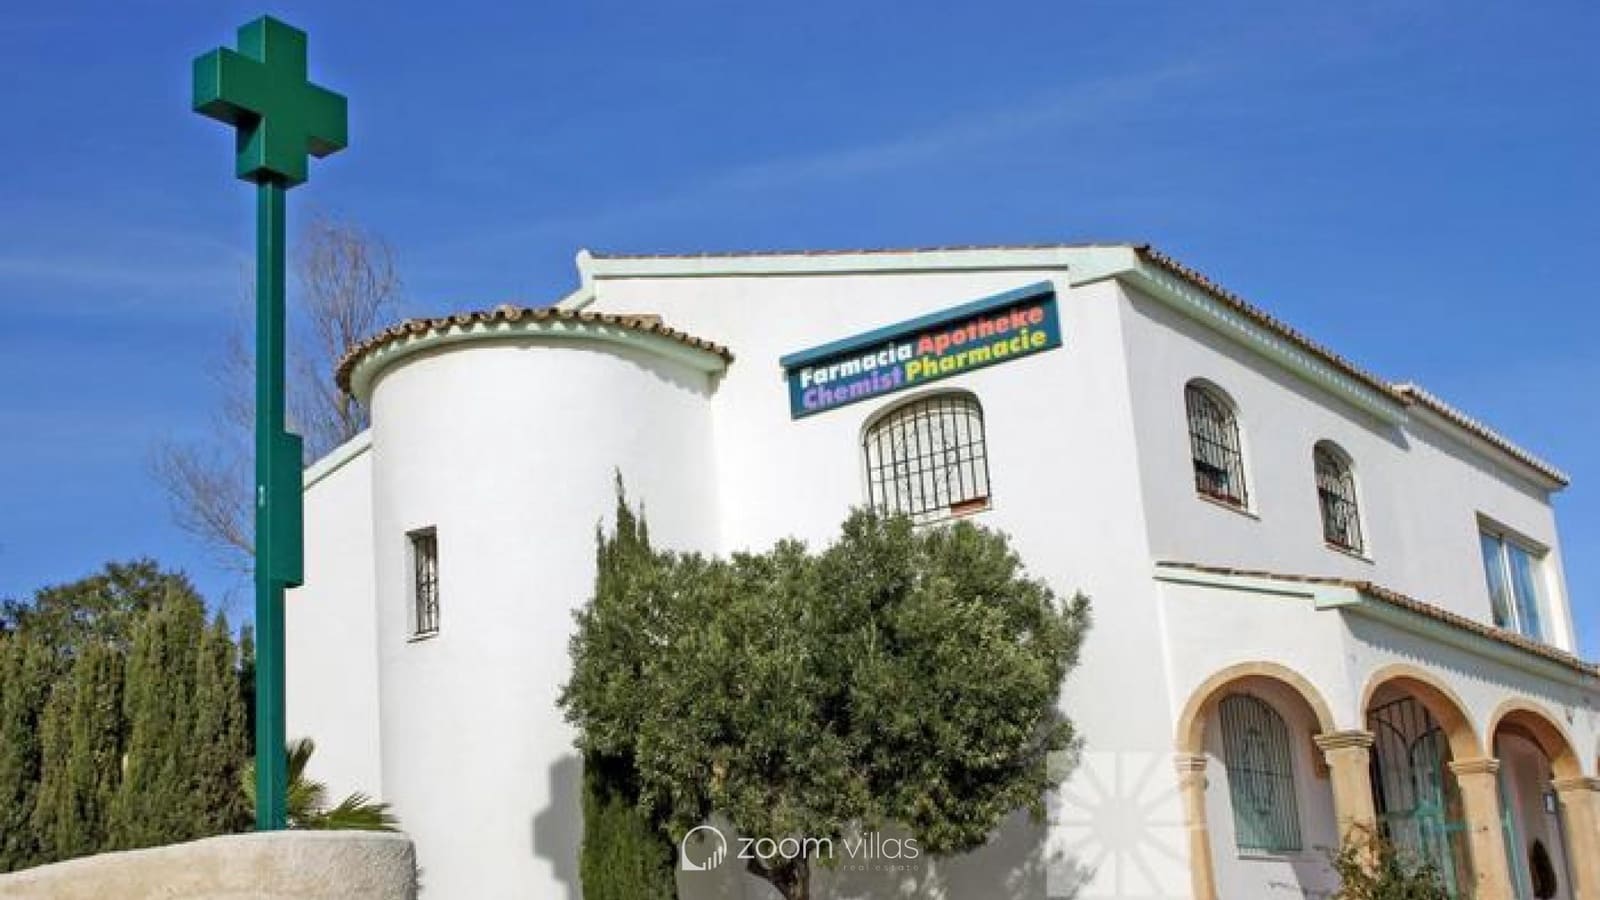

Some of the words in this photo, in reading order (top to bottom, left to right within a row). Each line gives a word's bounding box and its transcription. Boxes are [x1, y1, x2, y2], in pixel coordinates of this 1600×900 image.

[800, 342, 913, 388] Farmacia
[916, 304, 1045, 356] Apotheke
[803, 367, 904, 409] Chemist
[904, 326, 1047, 382] Pharmacie
